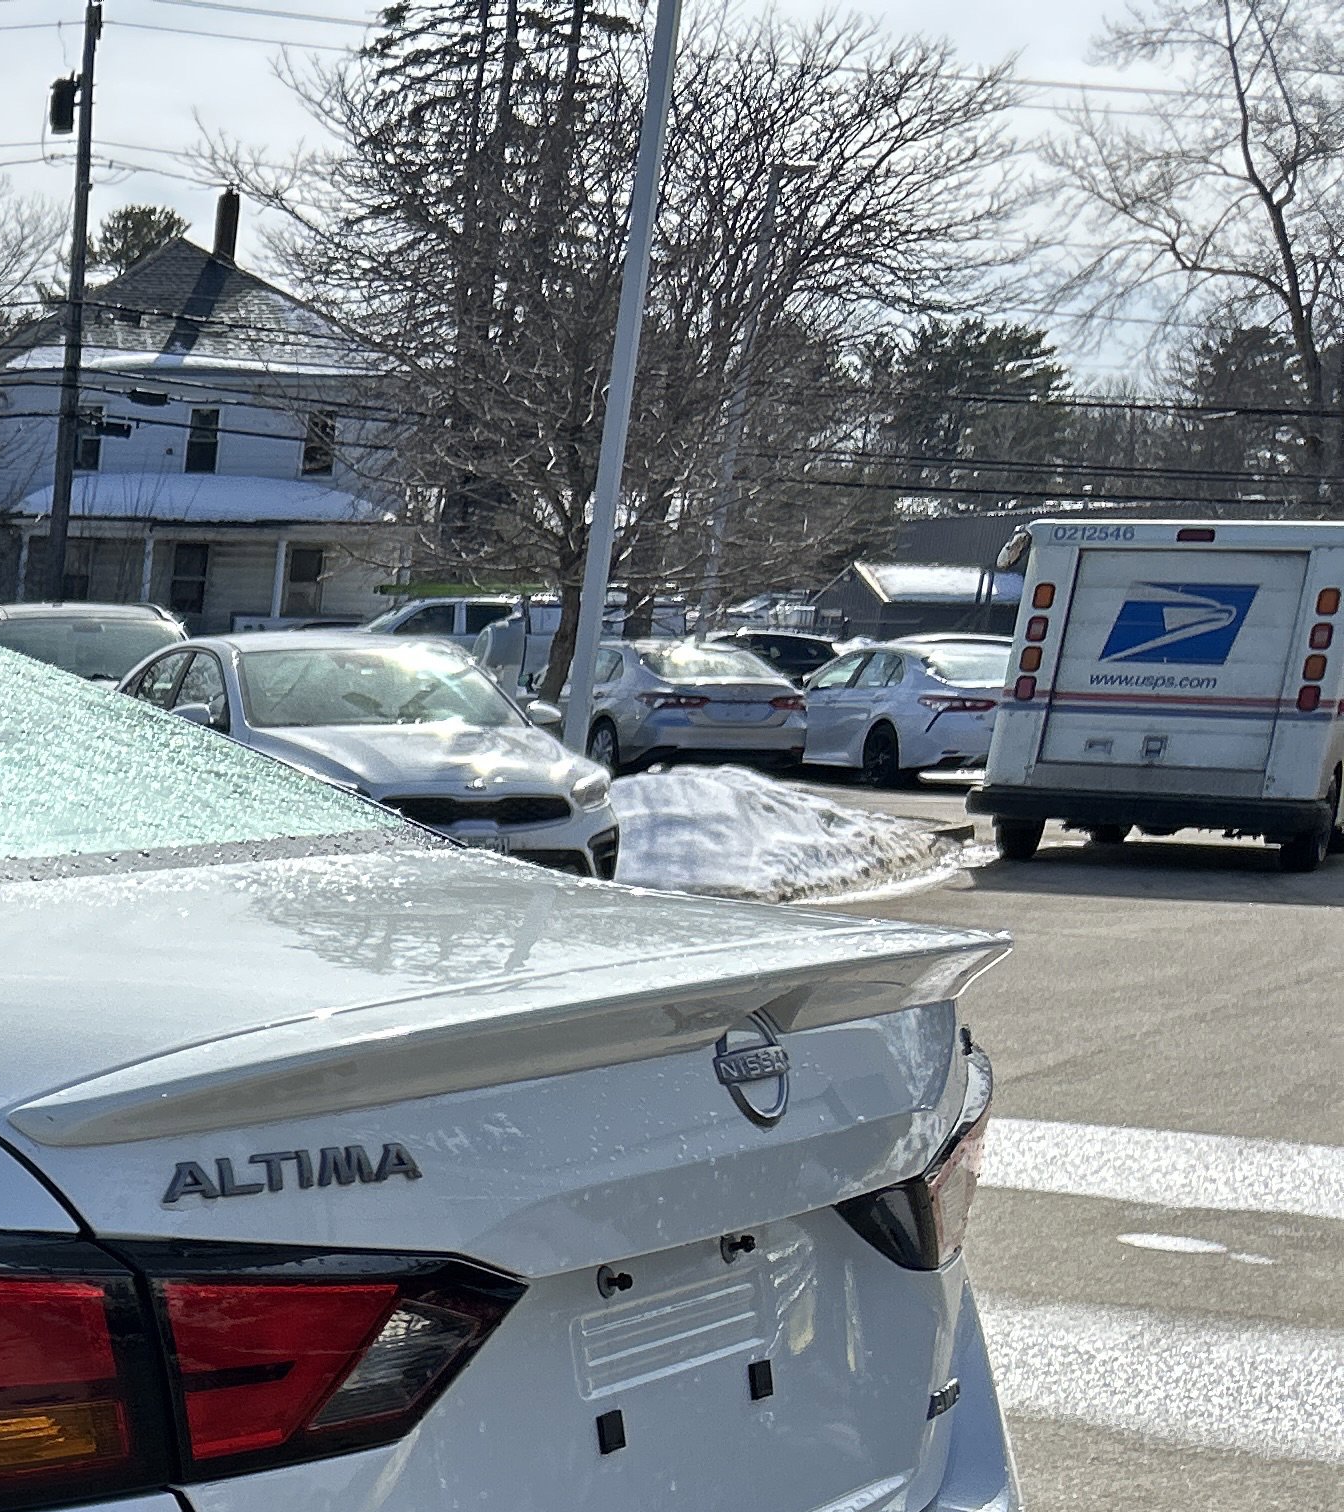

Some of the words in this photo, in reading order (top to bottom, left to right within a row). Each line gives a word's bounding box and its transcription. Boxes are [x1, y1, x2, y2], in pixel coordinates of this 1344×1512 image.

[1053, 526, 1135, 541] 0212546
[1089, 673, 1217, 690] www.usps.com
[162, 1142, 423, 1203] ALTIMA
